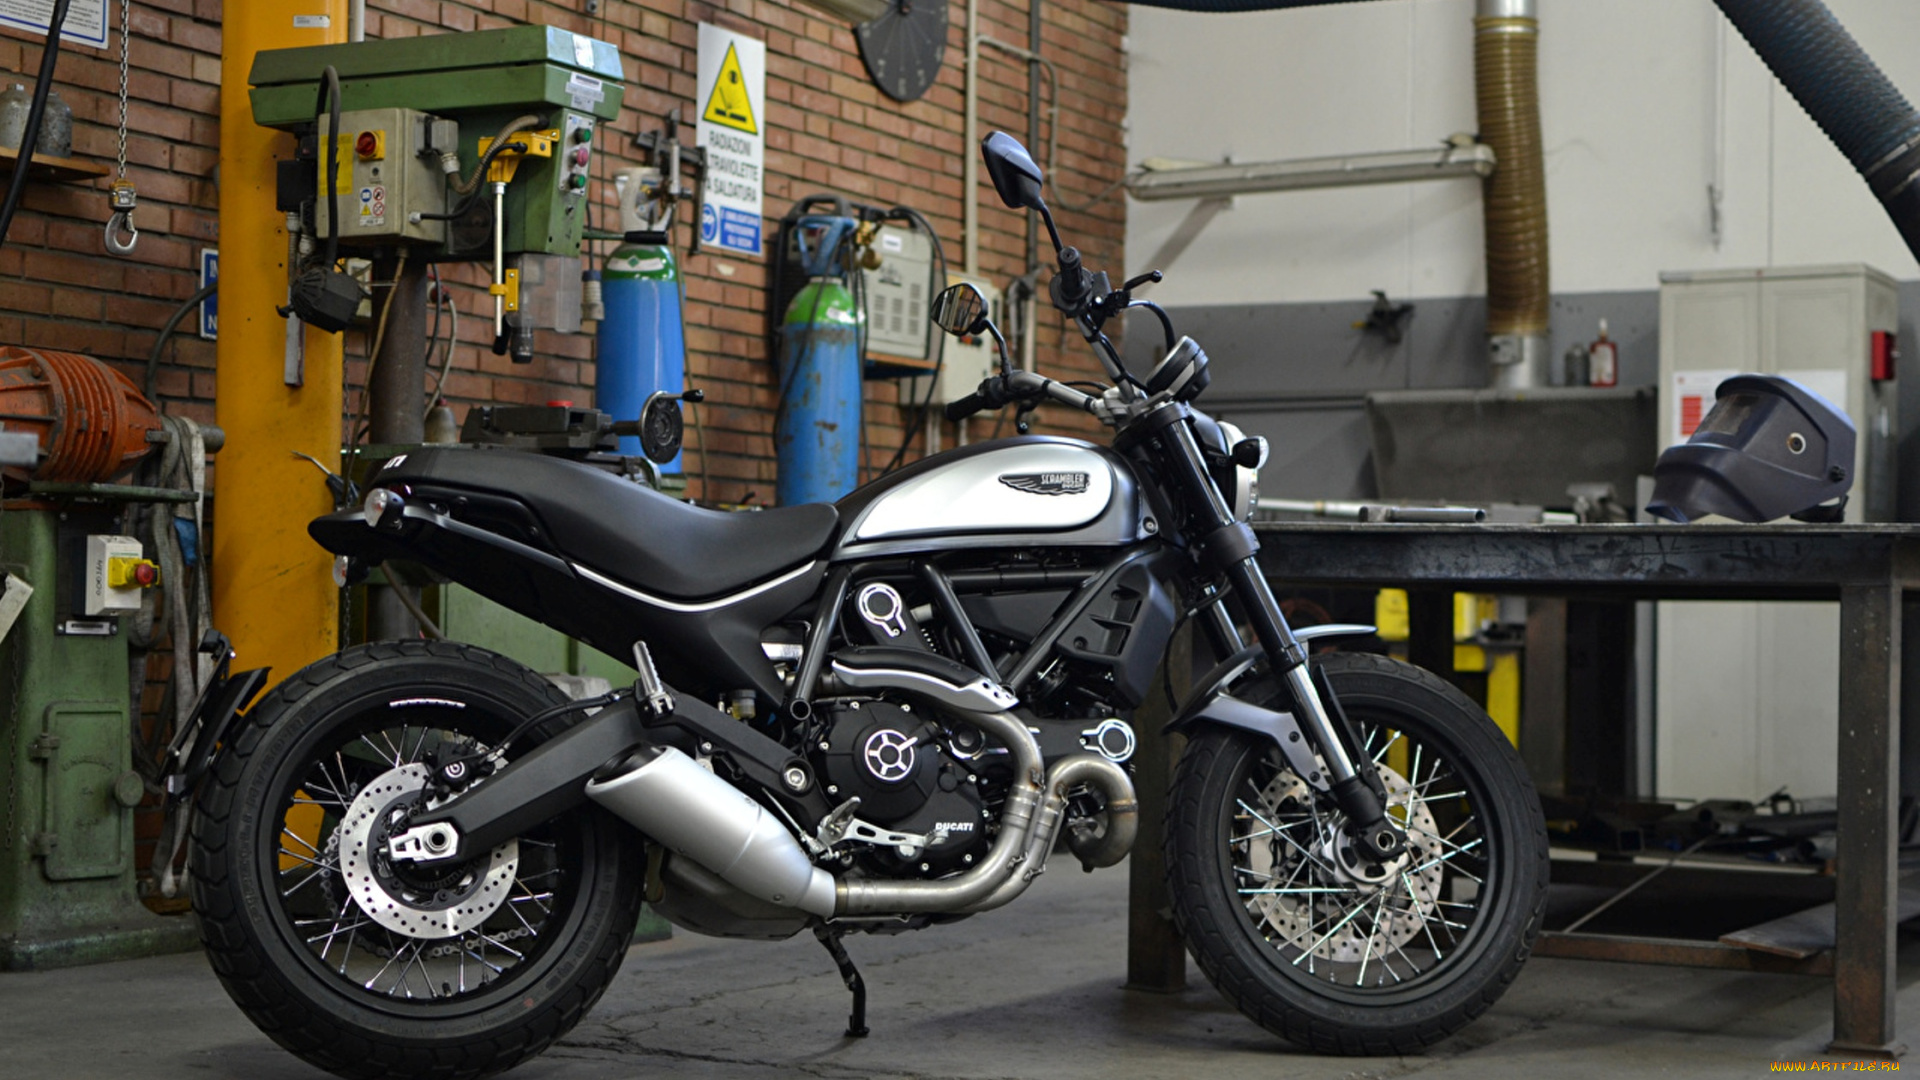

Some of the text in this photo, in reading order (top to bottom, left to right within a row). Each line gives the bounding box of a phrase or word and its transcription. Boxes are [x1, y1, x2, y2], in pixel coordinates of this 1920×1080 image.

[707, 152, 758, 182] TRAVIOLETTE
[1041, 473, 1085, 485] SCRAMBLER
[935, 821, 974, 831] DUCATI
